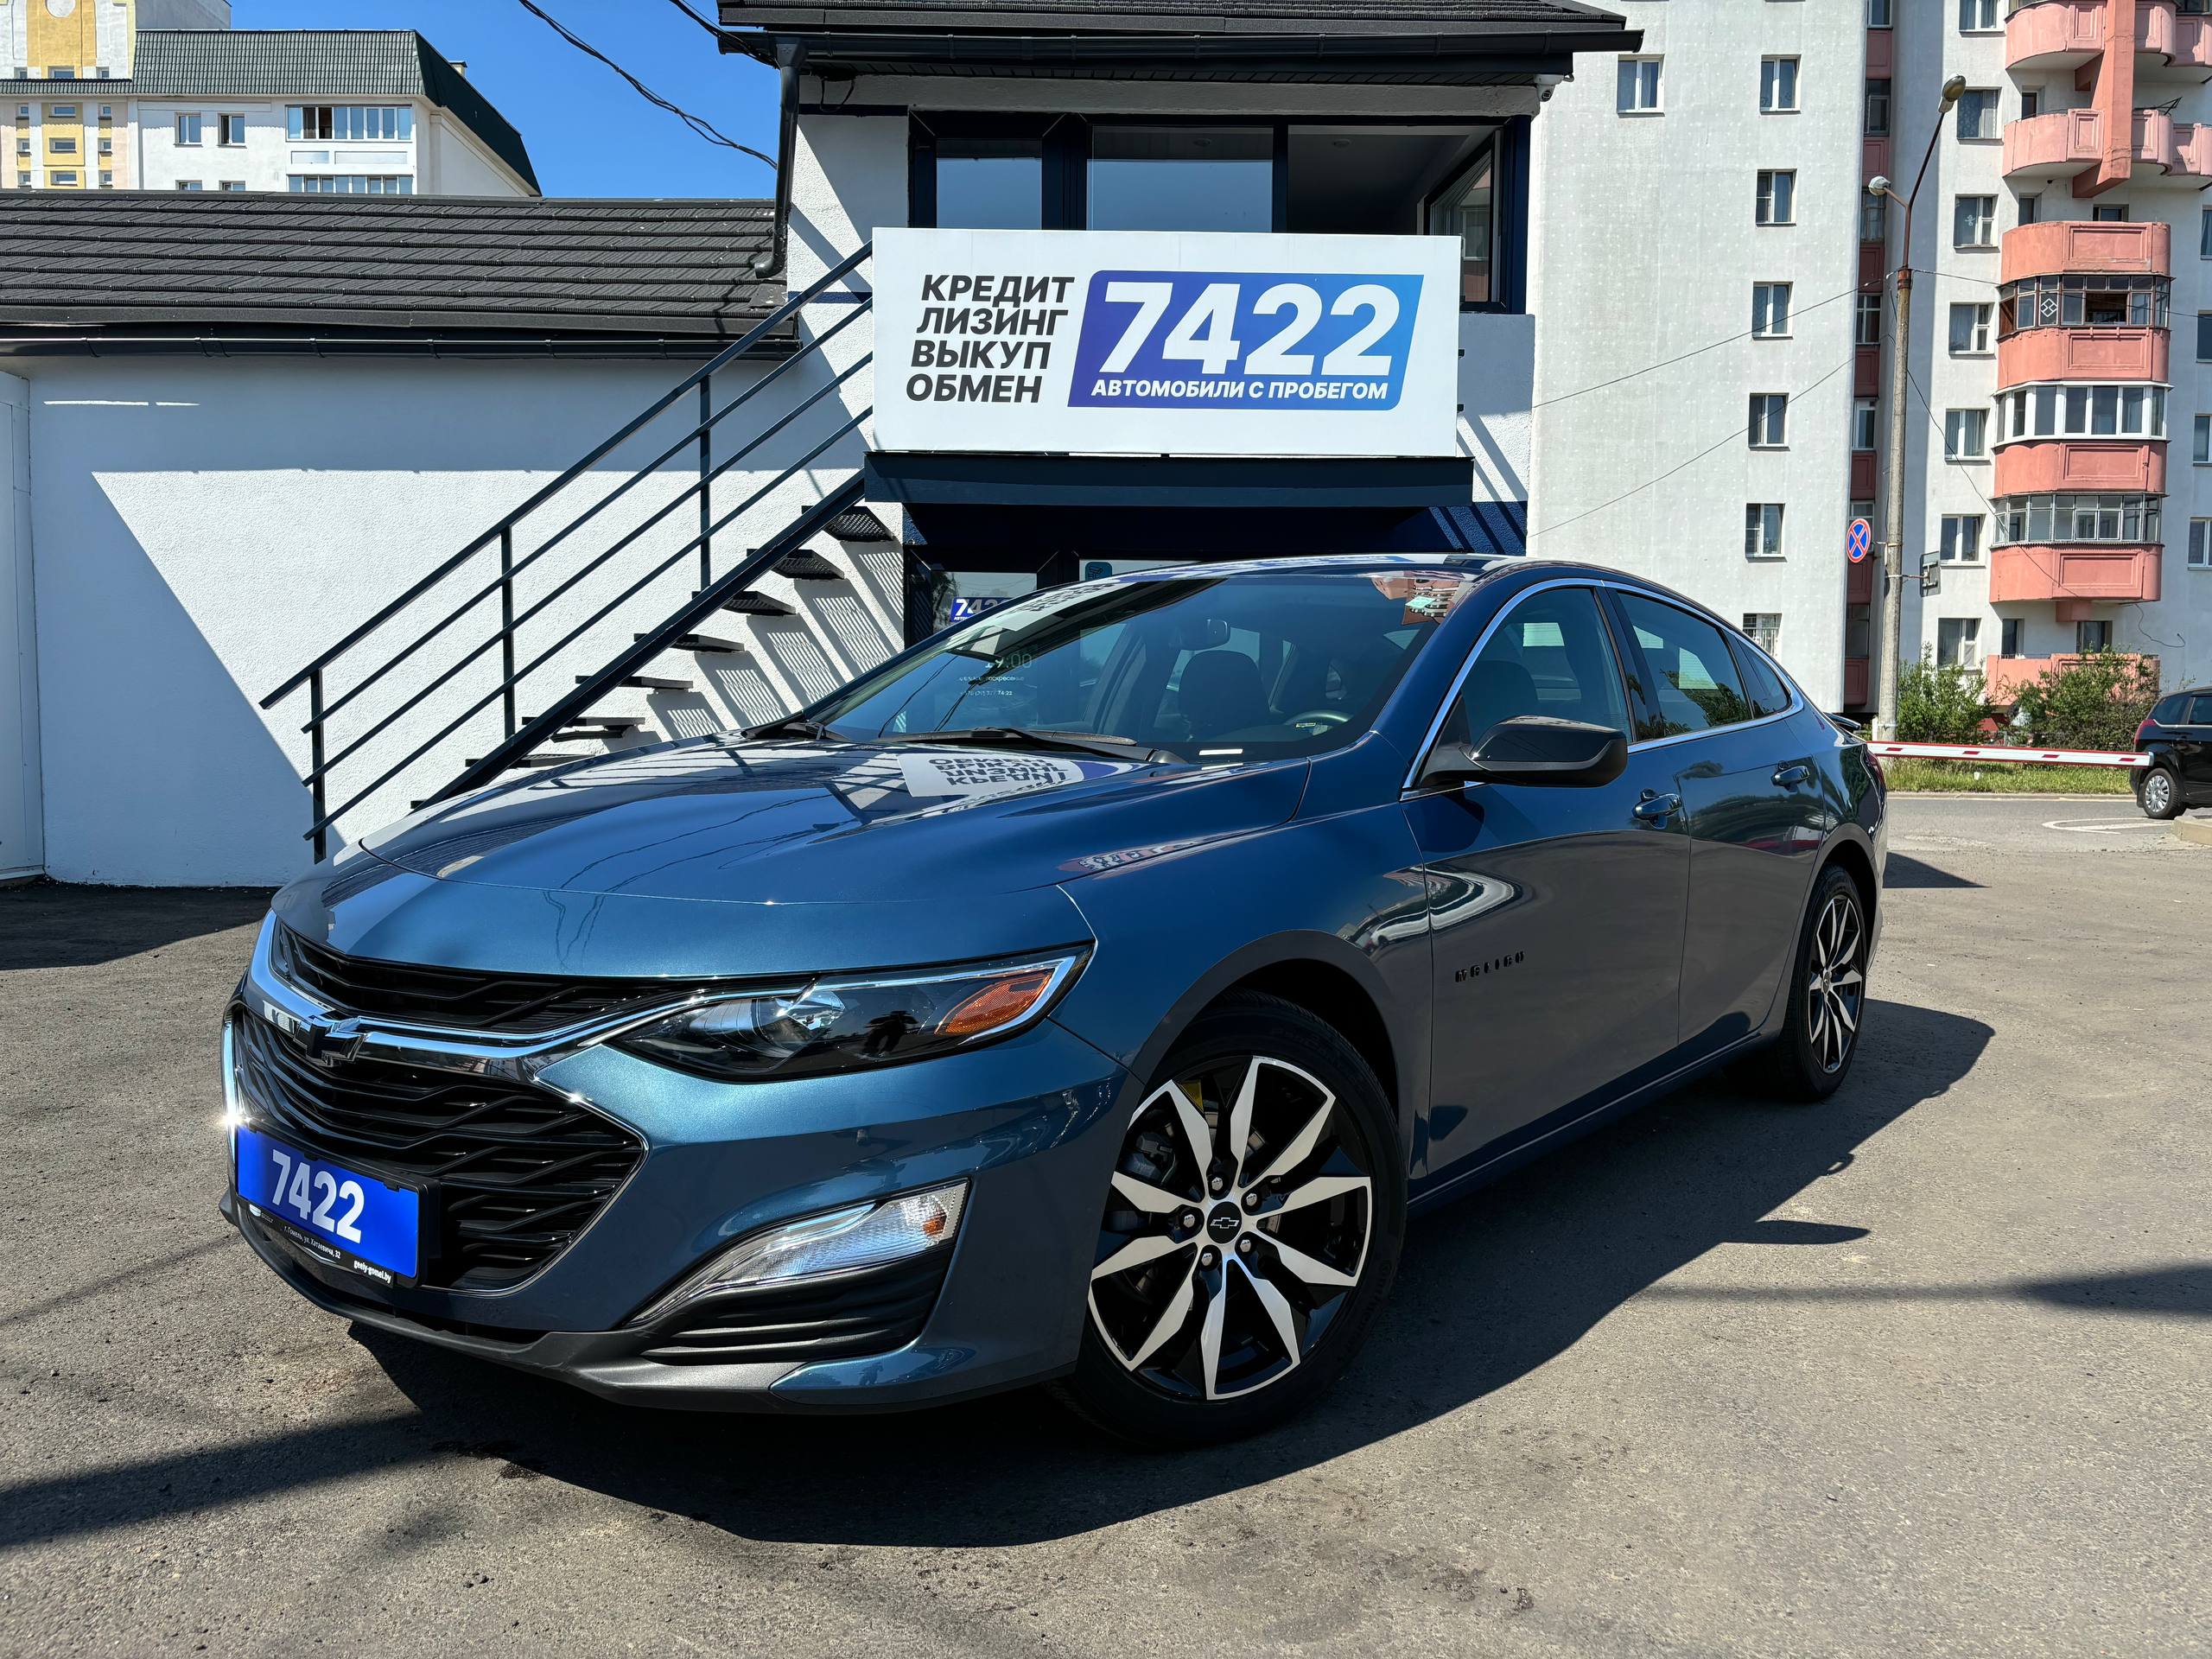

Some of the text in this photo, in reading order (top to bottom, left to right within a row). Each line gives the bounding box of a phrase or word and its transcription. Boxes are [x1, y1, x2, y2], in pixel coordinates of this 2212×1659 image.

[921, 274, 1075, 308] КРЕДИТ
[916, 308, 1068, 336] ЛИЗИНГ
[1099, 281, 1401, 376] 7422
[911, 340, 1051, 370] ВЫКУП
[906, 373, 1042, 404] ОБМЕН
[1090, 378, 1389, 400] АВТОМОБИЛИ С ПРОБЕГОМ
[956, 598, 1009, 617] 74
[272, 1148, 365, 1244] 7422
[353, 1261, 391, 1284] geely-gomel.by
